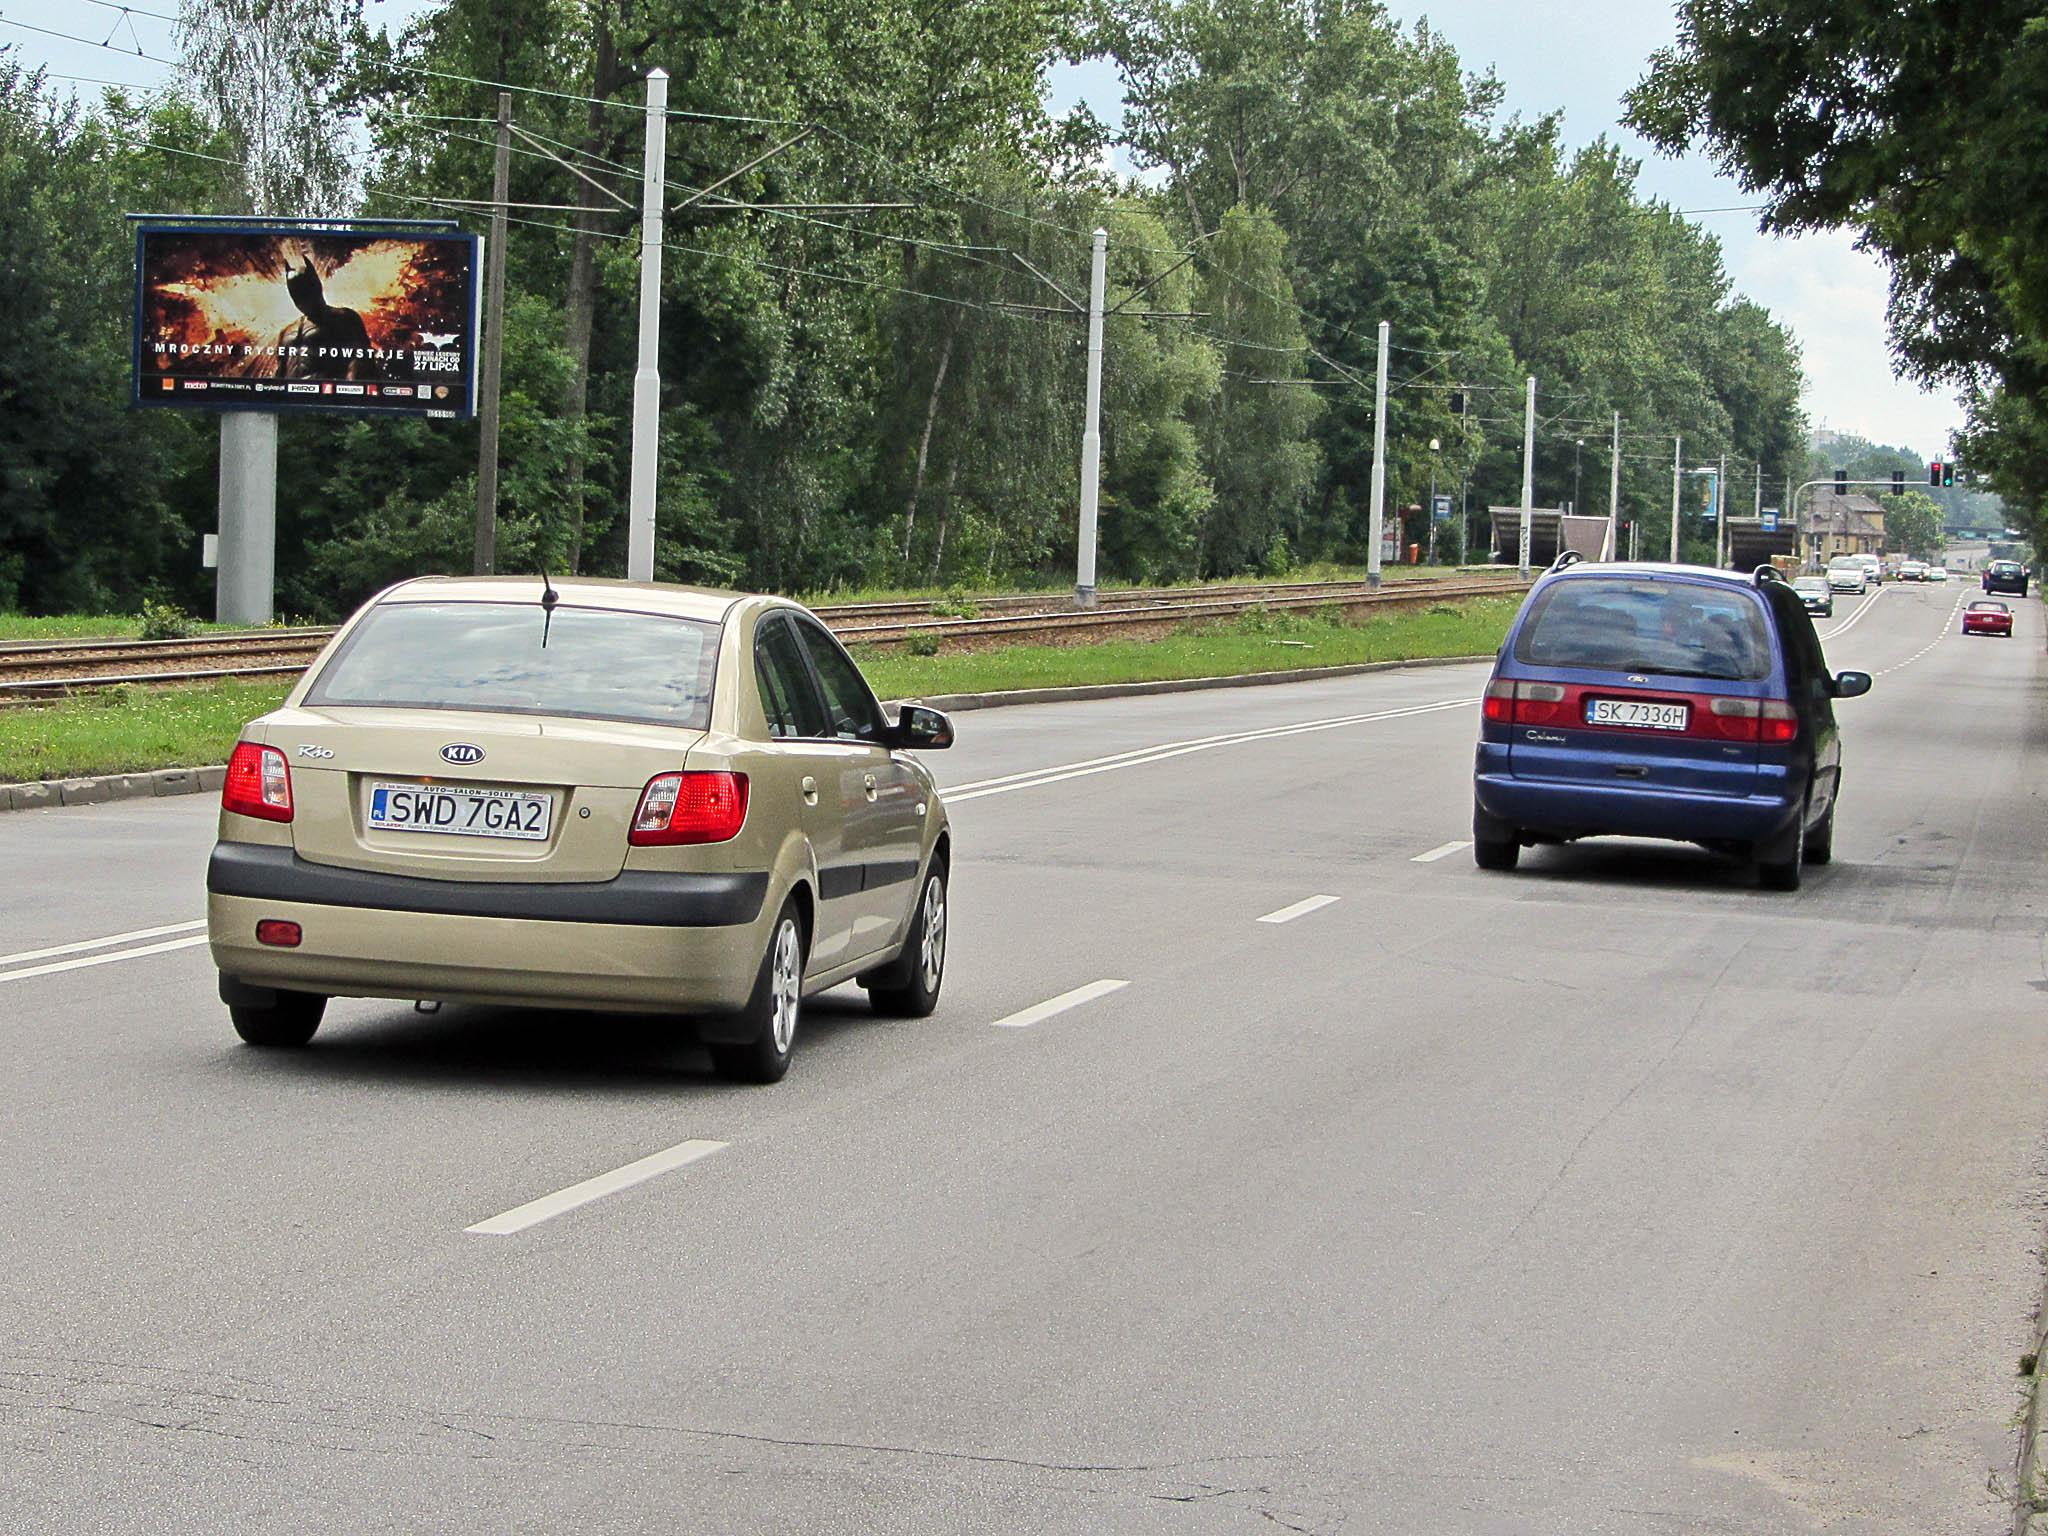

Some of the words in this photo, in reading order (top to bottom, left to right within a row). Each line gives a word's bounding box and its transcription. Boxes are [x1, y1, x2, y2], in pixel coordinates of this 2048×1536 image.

[155, 343, 234, 354] MROCZNY
[244, 345, 308, 357] RYCERZ
[319, 347, 404, 359] POWSTAJE
[413, 361, 427, 371] 27
[430, 362, 460, 372] LIPCA
[1598, 702, 1622, 720] SK
[1629, 704, 1684, 725] 7336H
[298, 744, 335, 759] Rio
[446, 747, 477, 760] KIA
[373, 809, 384, 819] PL
[391, 793, 457, 825] SWD
[466, 797, 542, 832] 7GA2
